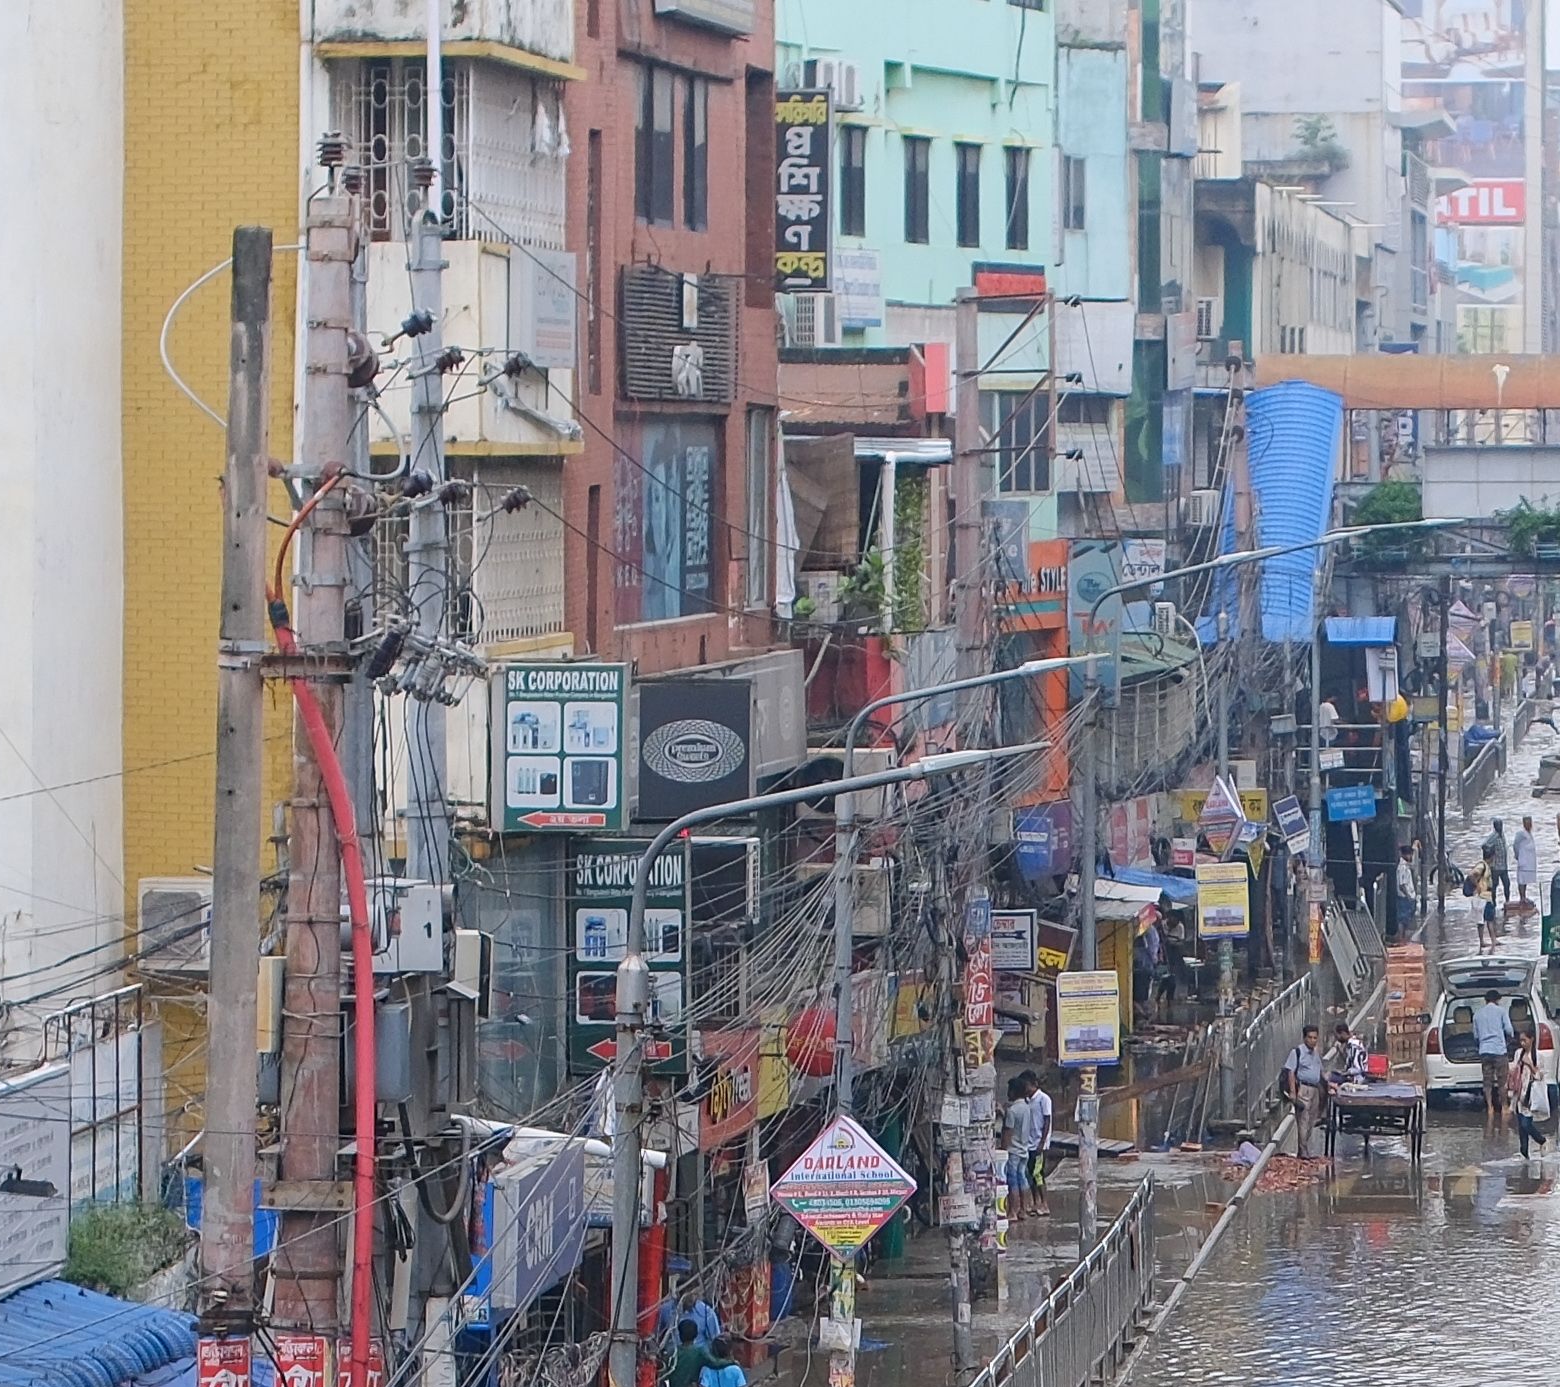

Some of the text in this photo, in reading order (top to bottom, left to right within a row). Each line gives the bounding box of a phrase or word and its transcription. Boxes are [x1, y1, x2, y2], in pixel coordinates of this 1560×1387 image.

[1040, 566, 1066, 592] STYLE
[508, 671, 619, 691] SK CORPORATION
[576, 855, 682, 886] SK CORPOTION
[804, 1155, 880, 1171] DARLAND
[791, 1170, 894, 1181] International School
